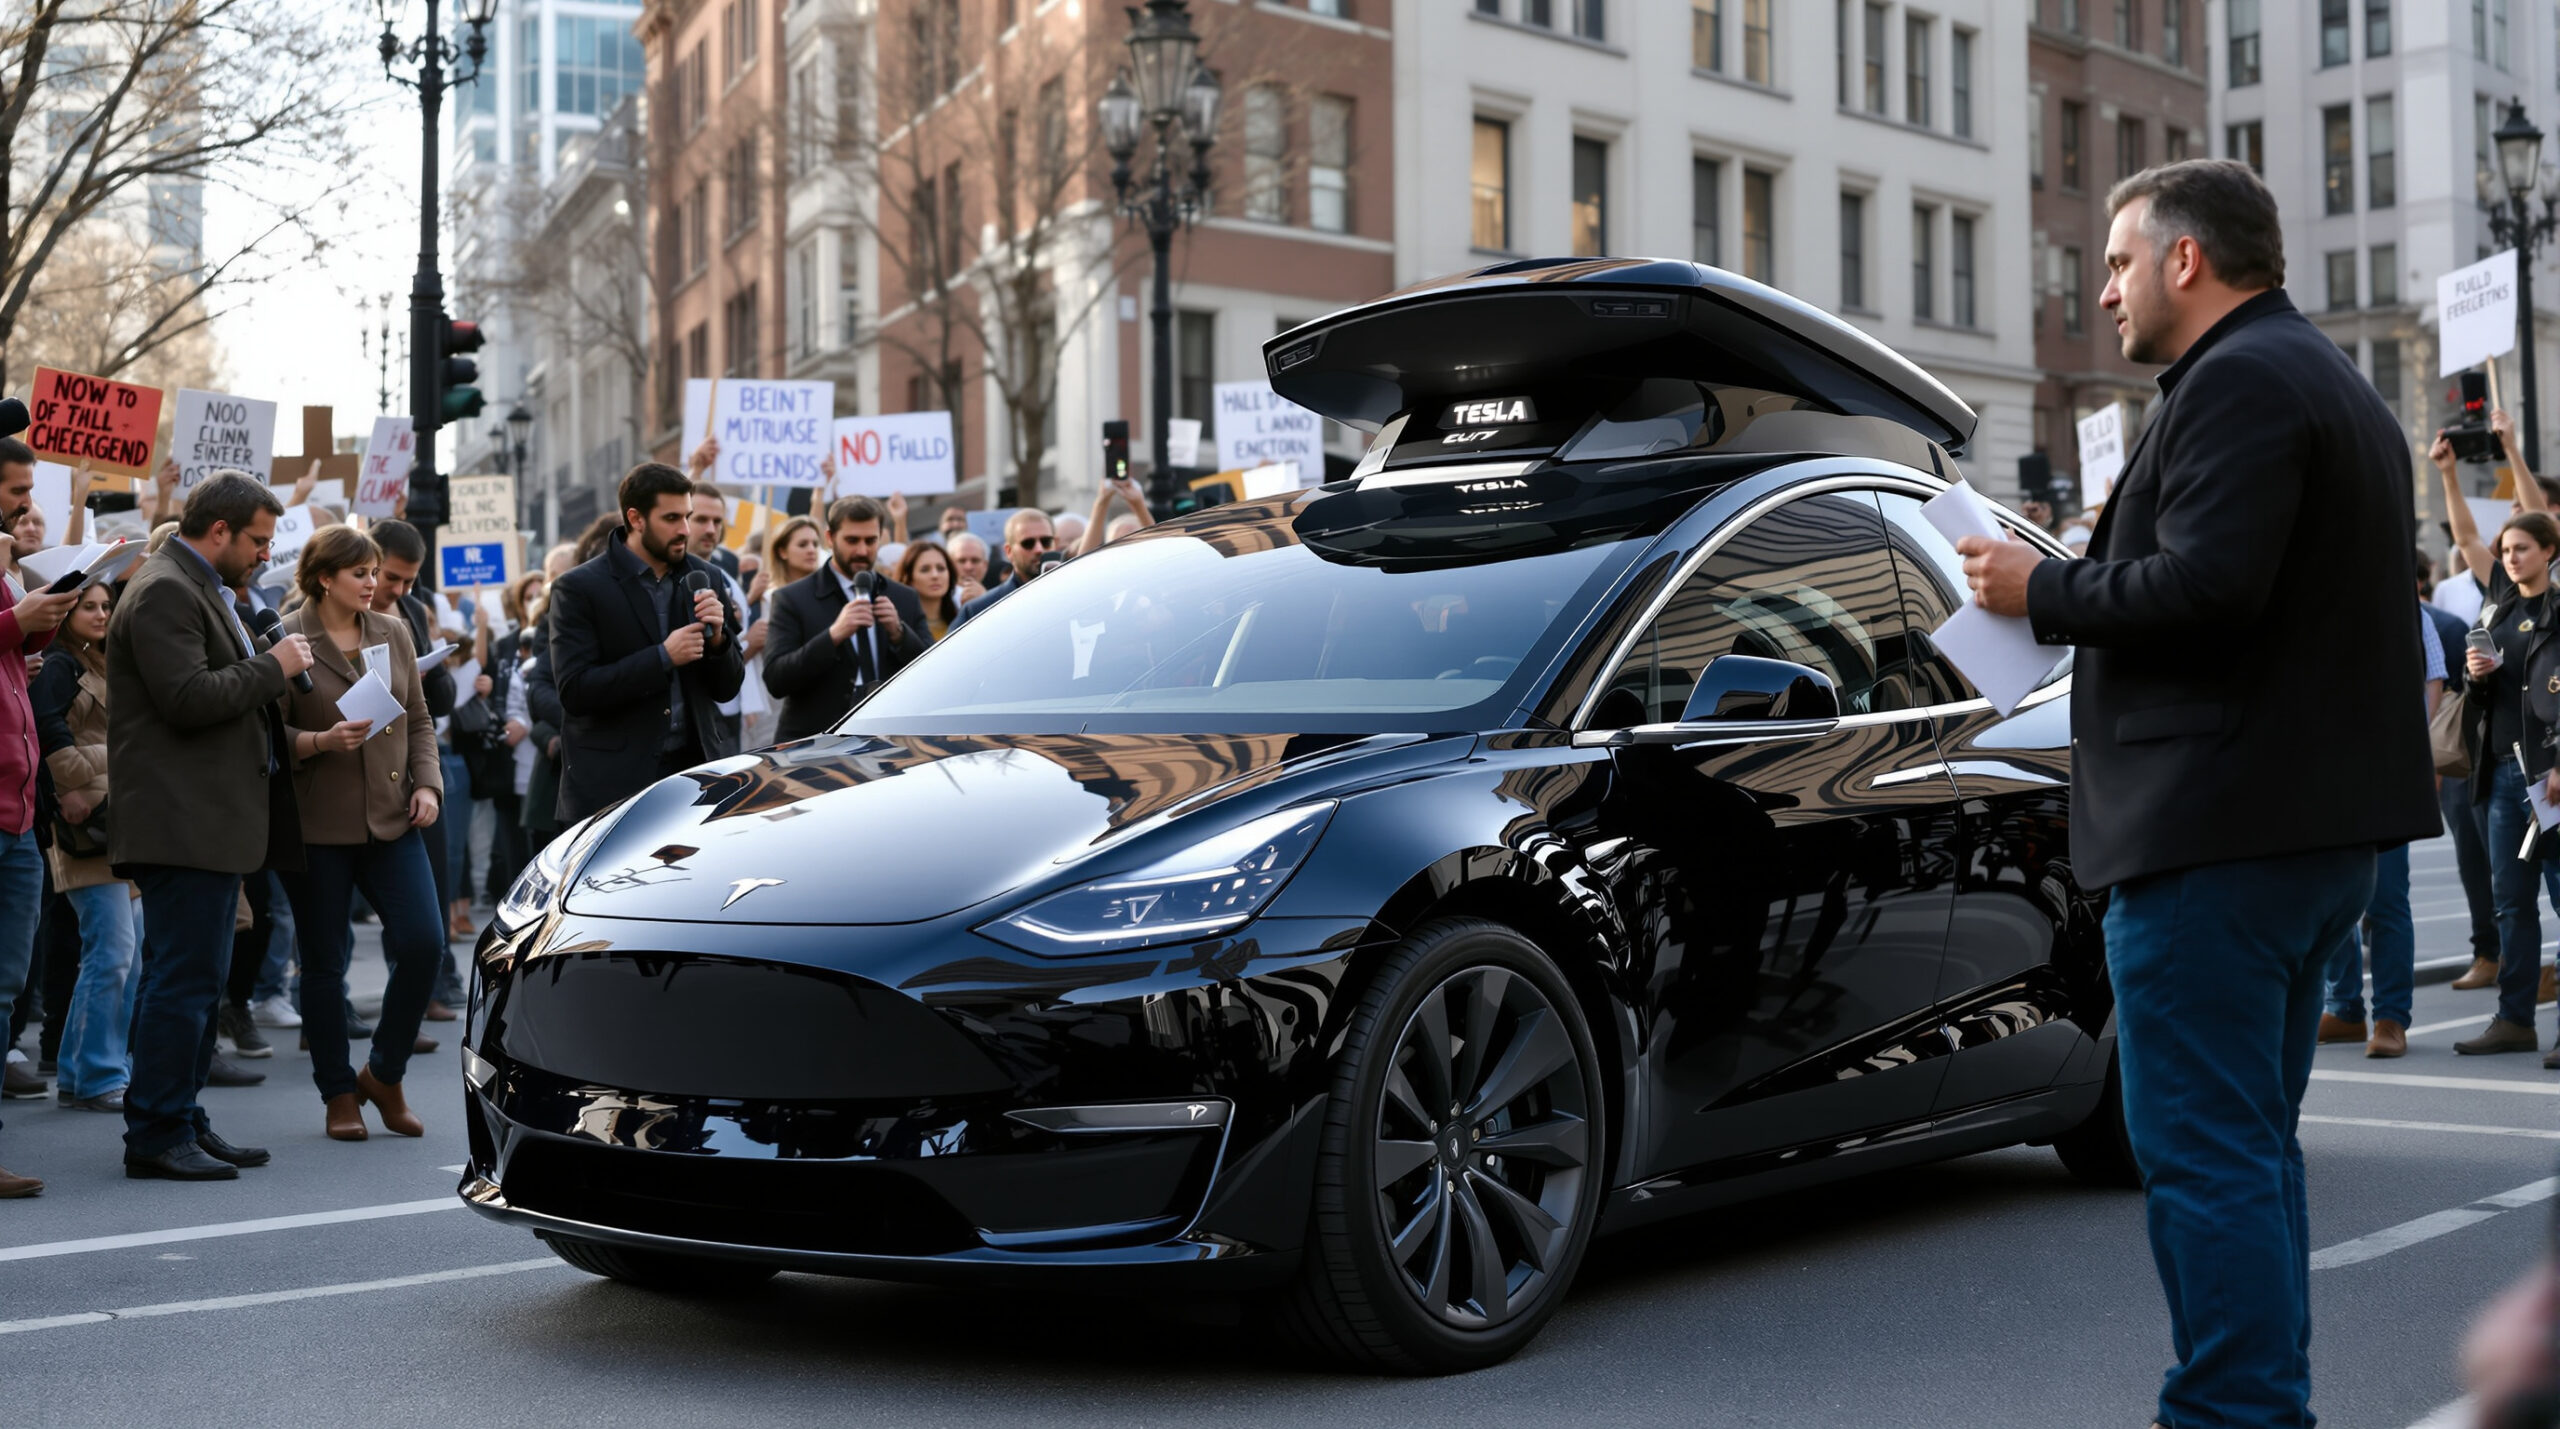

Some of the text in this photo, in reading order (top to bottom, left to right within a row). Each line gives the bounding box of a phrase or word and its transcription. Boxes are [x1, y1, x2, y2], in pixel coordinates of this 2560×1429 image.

[54, 374, 138, 409] NOW TO
[35, 399, 59, 422] OF
[205, 401, 247, 425] NOO
[1453, 401, 1528, 426] TESLA
[841, 429, 949, 468] NO FULLD
[731, 451, 819, 481] CLENDS
